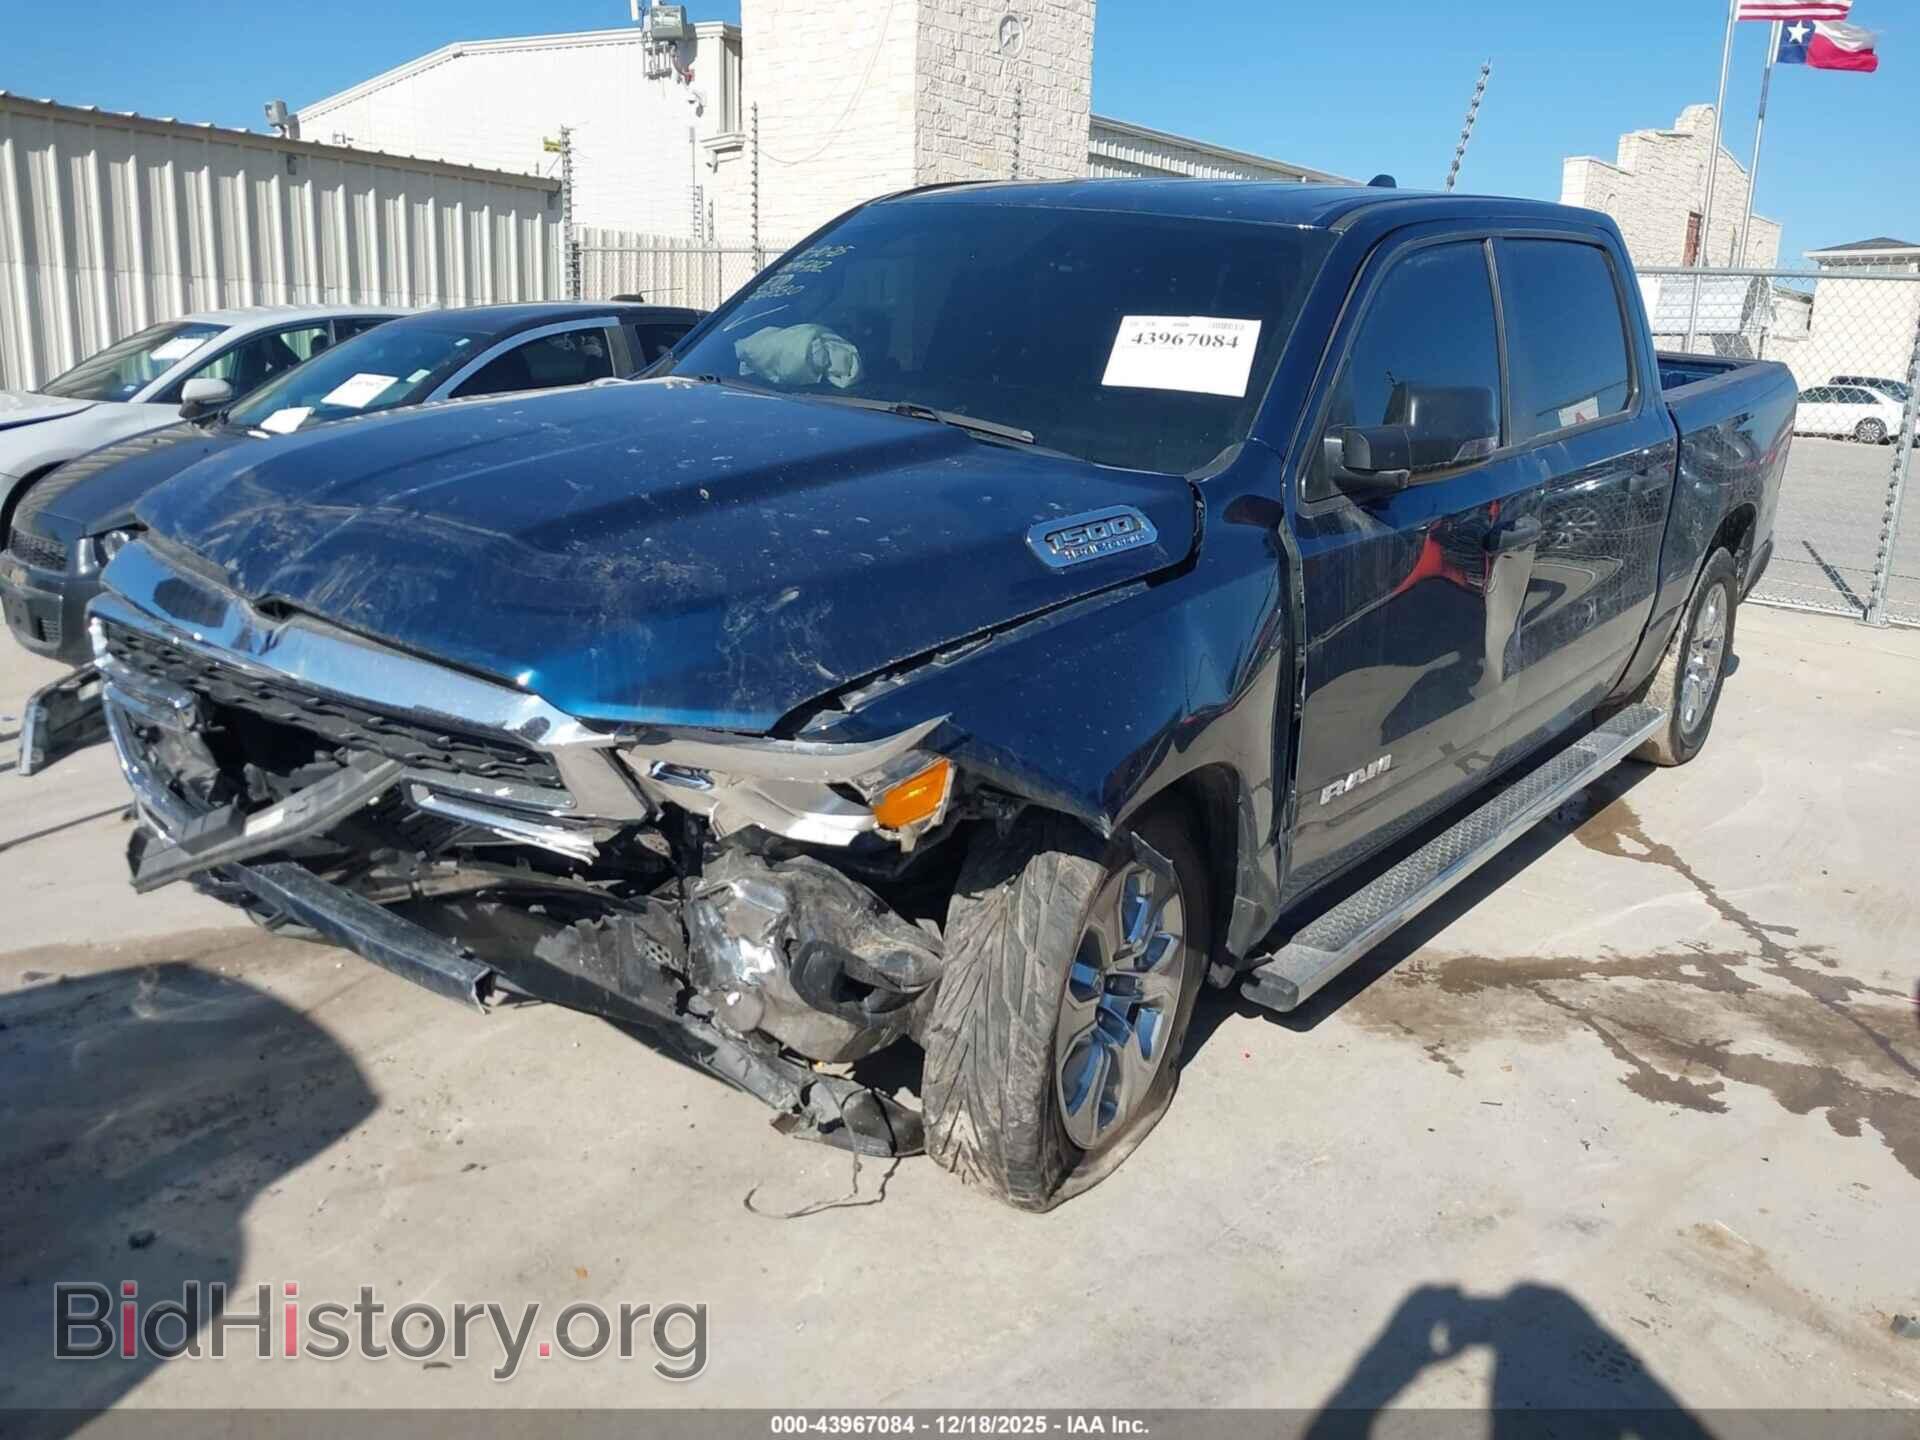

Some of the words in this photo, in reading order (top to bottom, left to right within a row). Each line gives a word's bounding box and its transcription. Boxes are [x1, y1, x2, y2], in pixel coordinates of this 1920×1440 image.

[1131, 332, 1239, 348] 43967084
[1046, 515, 1135, 551] 1500
[1319, 753, 1393, 806] RAM
